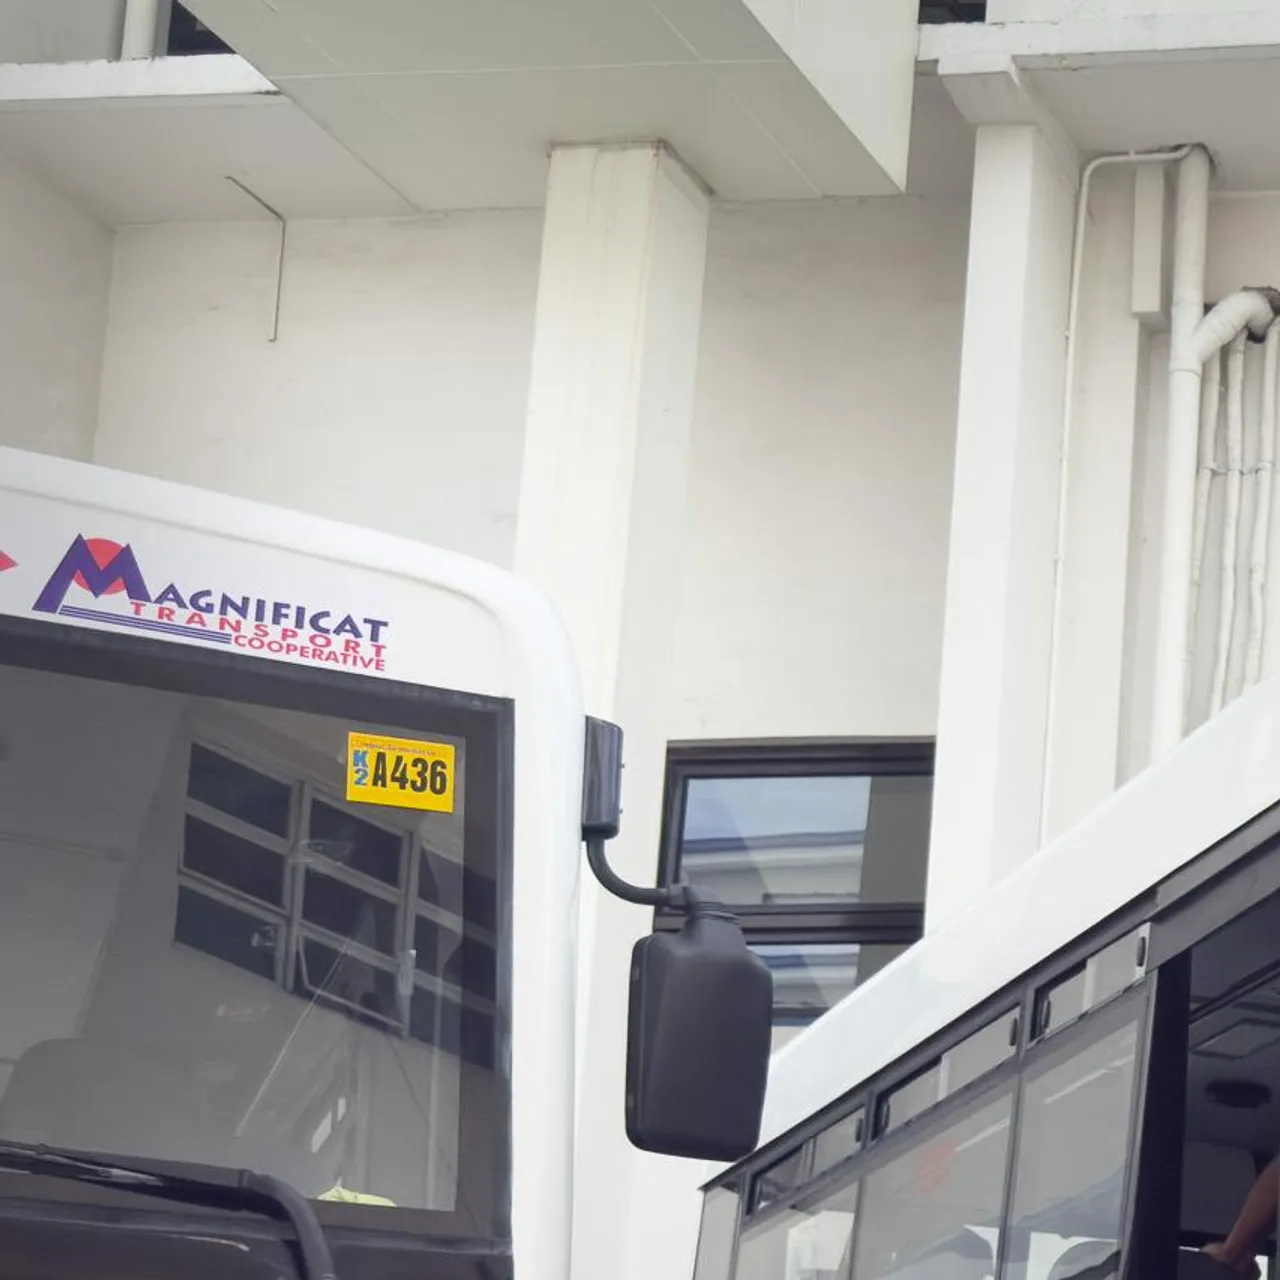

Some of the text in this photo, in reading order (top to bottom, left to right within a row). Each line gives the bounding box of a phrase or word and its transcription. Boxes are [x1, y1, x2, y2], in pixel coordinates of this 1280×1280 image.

[31, 533, 390, 645] MAGNIFICAT
[130, 600, 388, 660] TRANSPORT
[232, 632, 386, 672] COOPERATIVE
[371, 751, 448, 795] A436
